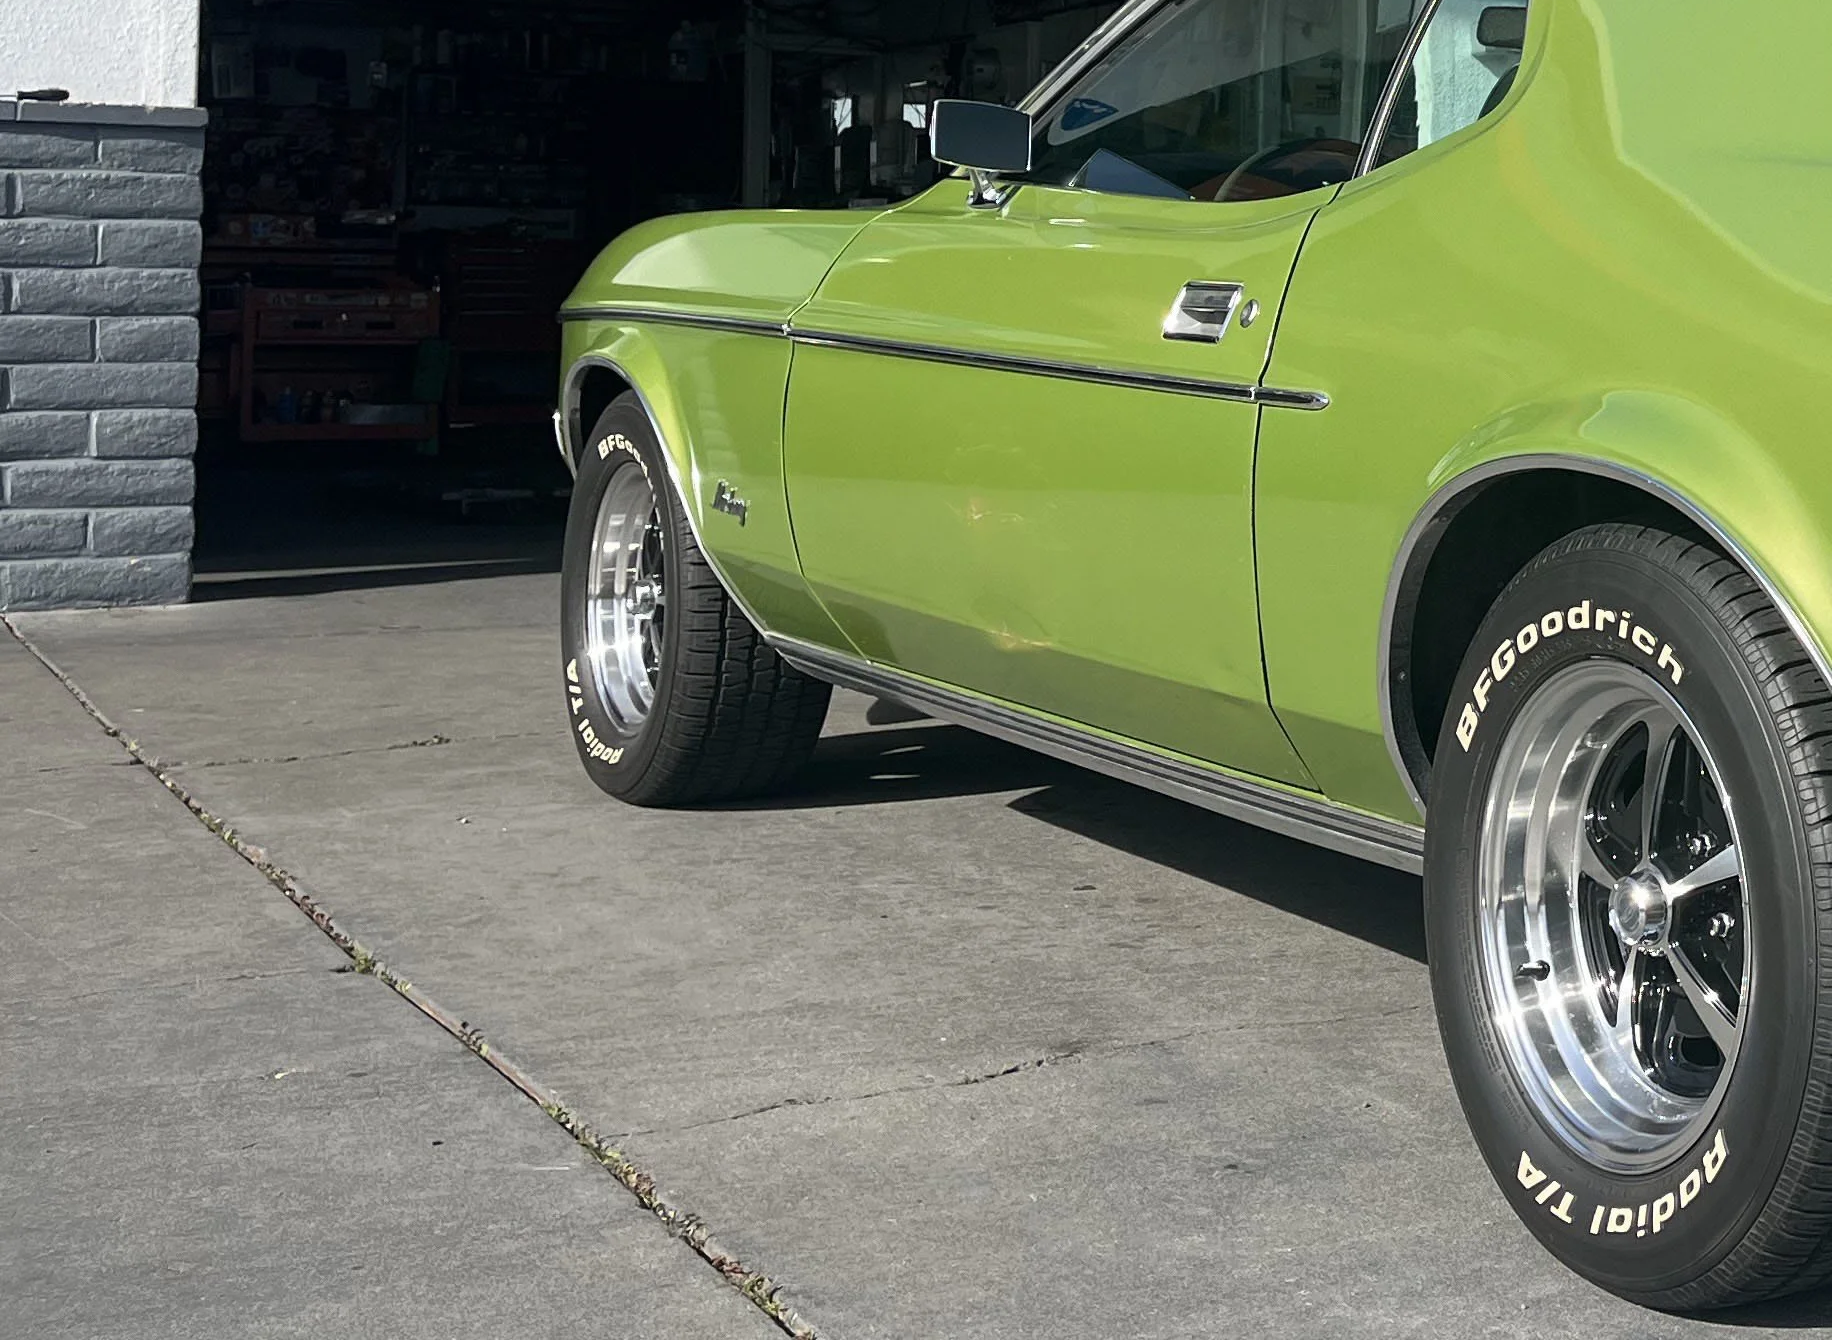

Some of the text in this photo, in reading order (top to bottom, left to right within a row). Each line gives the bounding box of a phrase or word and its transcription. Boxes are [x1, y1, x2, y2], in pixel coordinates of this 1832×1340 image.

[1455, 599, 1685, 753] BFGoodrich
[1516, 1128, 1728, 1238] Radial T/A
